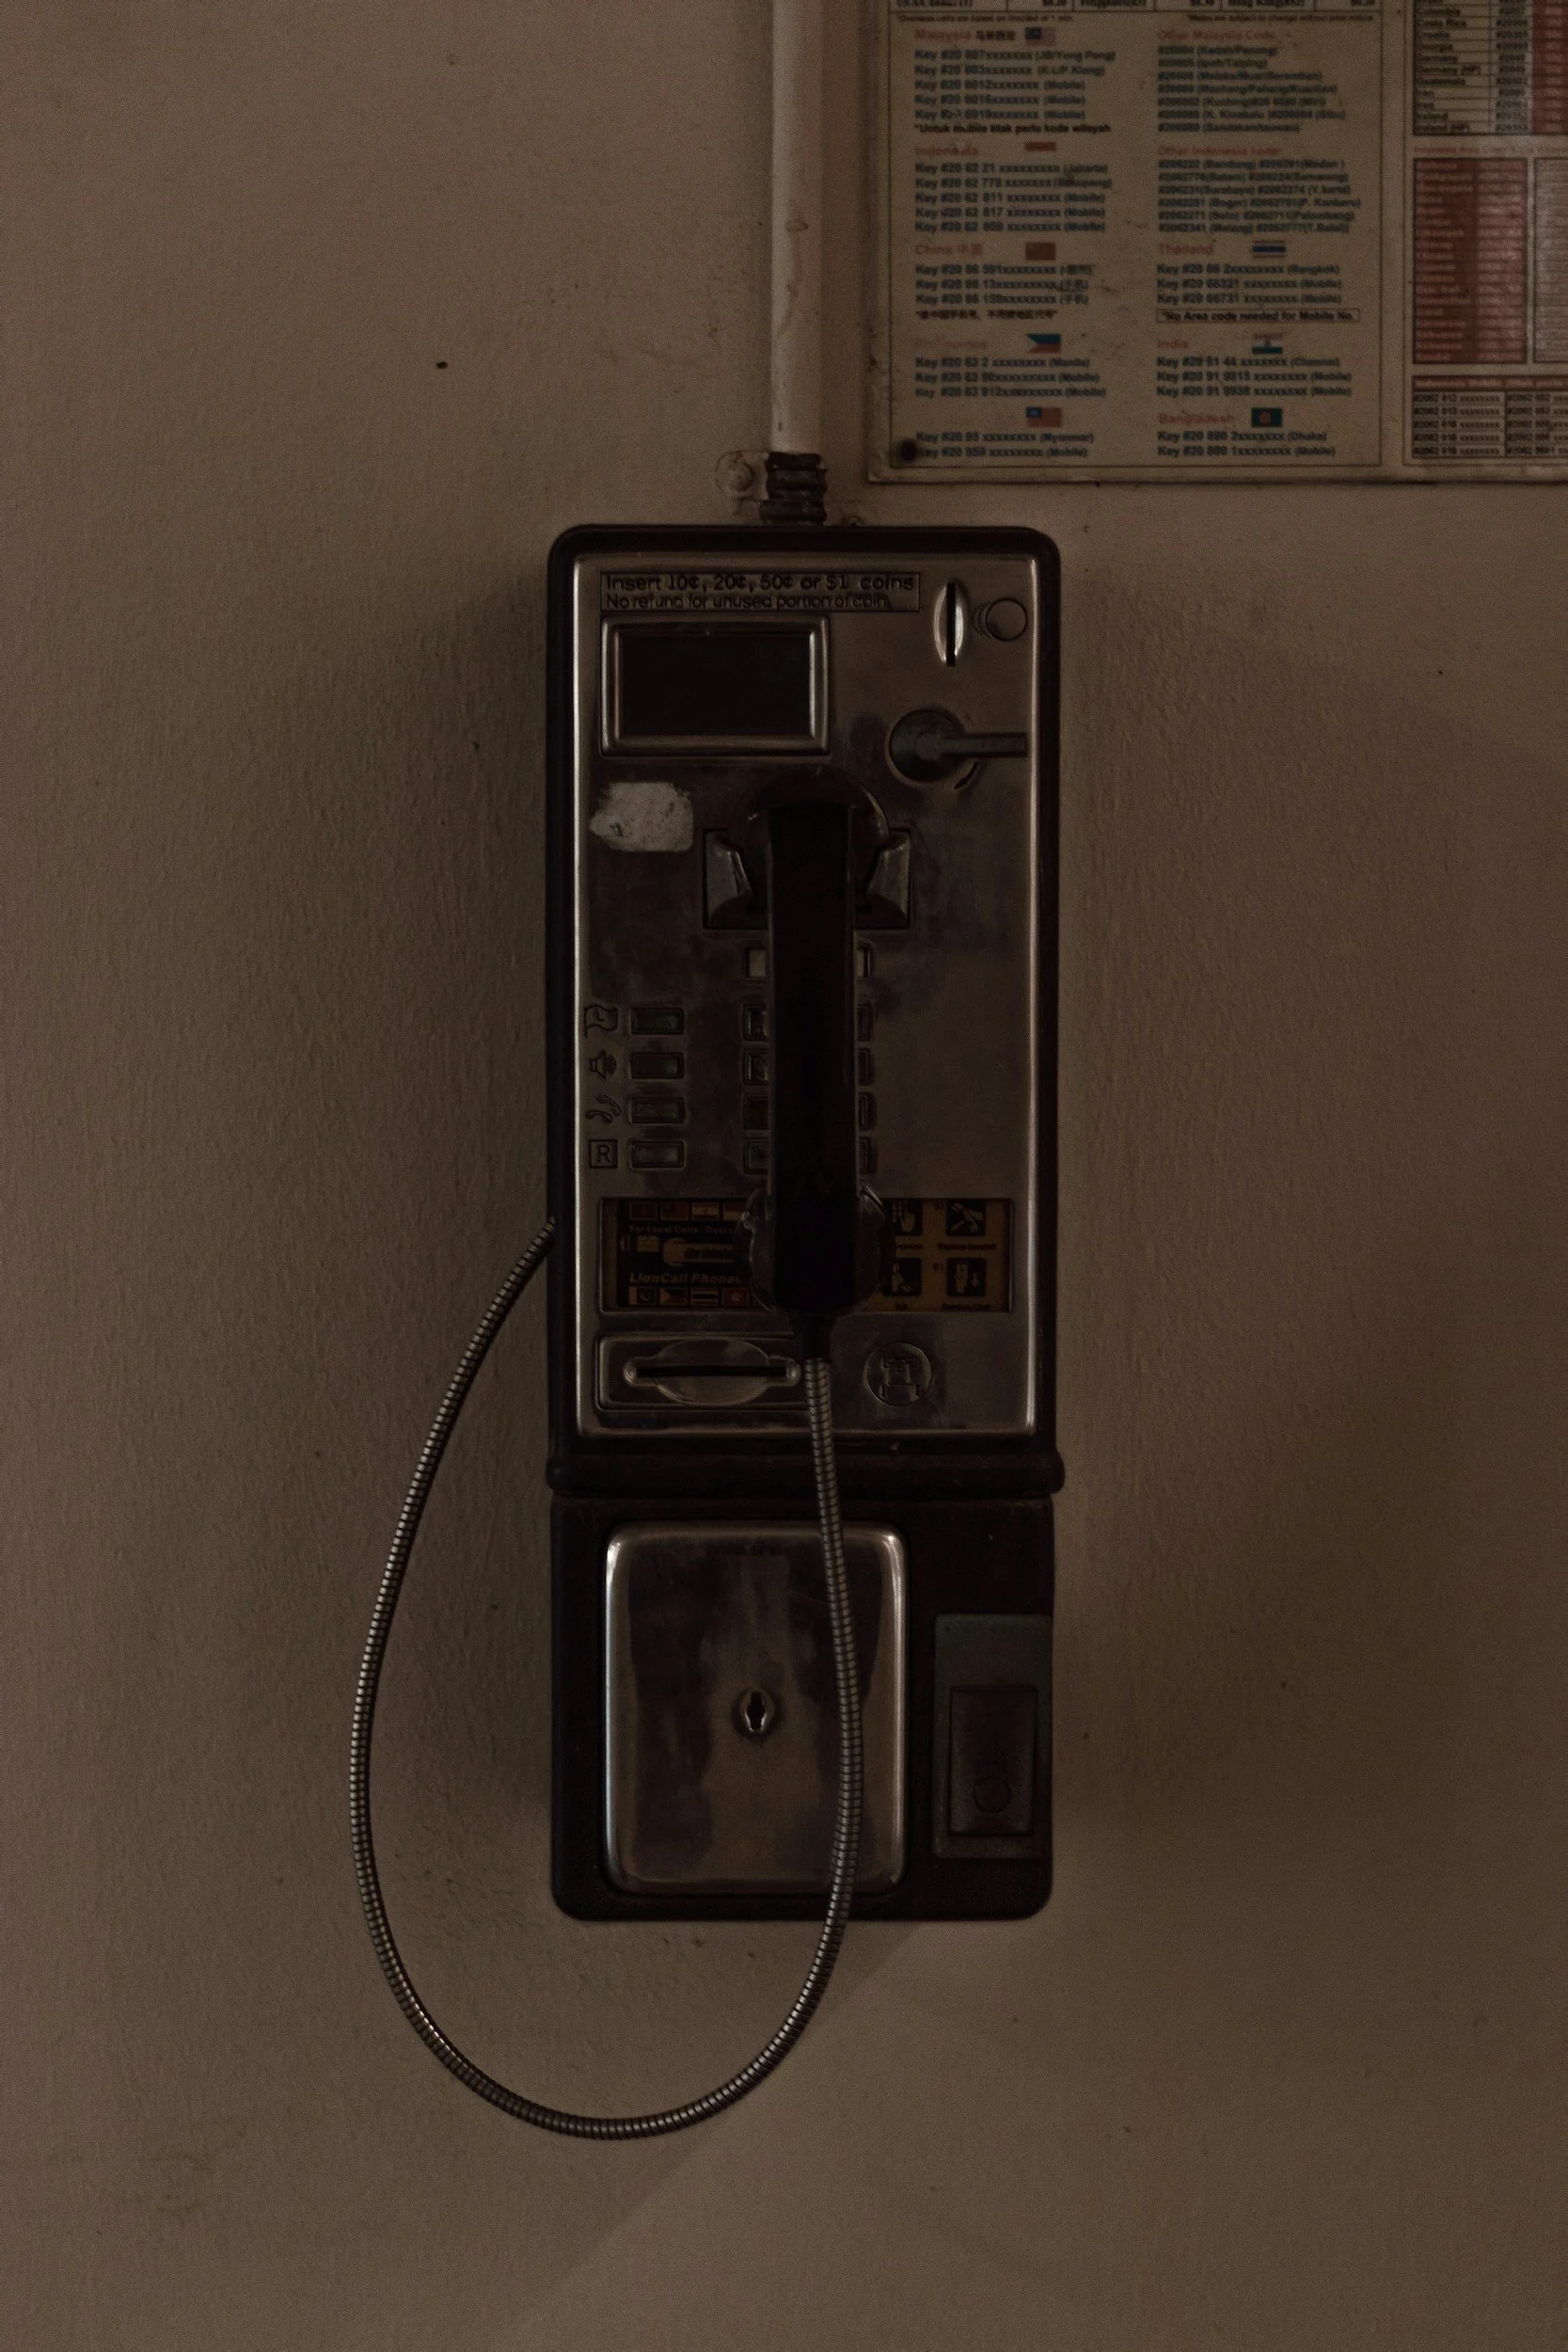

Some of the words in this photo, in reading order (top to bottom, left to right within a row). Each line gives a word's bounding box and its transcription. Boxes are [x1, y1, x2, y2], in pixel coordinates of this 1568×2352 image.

[914, 50, 937, 60] Key
[914, 66, 937, 76] Key
[914, 80, 938, 91] Key
[1044, 81, 1085, 89] (Mobile)
[914, 95, 937, 106] Key
[1044, 95, 1085, 104] (Mobile)
[915, 110, 937, 120] Key
[1044, 110, 1085, 119] (Mobile)
[1045, 124, 1069, 133] kode
[915, 163, 938, 175] Key
[915, 178, 938, 189] Key
[915, 193, 938, 204] Key
[1064, 194, 1105, 202] (Mobile)
[915, 208, 938, 219] Key
[915, 222, 937, 233] Key
[1064, 222, 1106, 231] (Mobile)
[915, 244, 953, 255] China
[1159, 244, 1214, 255] Thailand
[915, 264, 939, 276] Key
[1157, 264, 1179, 275] Key
[1287, 265, 1339, 275] (Bangkok)
[915, 279, 938, 291] Key
[1157, 278, 1179, 291] Key
[1300, 279, 1342, 289] (Mobile)
[915, 294, 938, 305] Key
[1157, 294, 1180, 305] Key
[1184, 312, 1208, 321] Area
[1211, 312, 1237, 321] code
[1240, 312, 1278, 321] needed
[1282, 312, 1295, 321] for
[1299, 312, 1334, 321] Mobile
[1158, 340, 1189, 349] India
[915, 358, 938, 368] Key
[1157, 358, 1179, 368] Key
[1224, 357, 1237, 366] 44
[915, 373, 938, 384] Key
[1058, 373, 1100, 382] (Mobile)
[1157, 372, 1180, 383] Key
[1310, 372, 1352, 381] (Mobile)
[915, 388, 938, 398] Key
[1065, 388, 1106, 396] (Mobile)
[1156, 387, 1180, 398] Key
[1310, 387, 1352, 396] (Mobile)
[914, 432, 938, 445] Key
[1157, 431, 1180, 442] Key
[1288, 432, 1327, 441] (Dhaka)
[917, 445, 938, 460] Key
[1158, 446, 1180, 457] Key
[1294, 447, 1336, 456] (Mobile)
[607, 575, 661, 590] Insert
[669, 575, 708, 596] 10¢,
[715, 575, 755, 596] 20¢,
[761, 575, 793, 590] 50¢
[800, 579, 822, 590] or
[827, 575, 847, 592] $1
[861, 575, 915, 590] coins
[607, 594, 632, 609] No
[634, 594, 684, 609] refund
[687, 594, 708, 609] for
[714, 594, 771, 609] unused
[778, 594, 833, 612] portion
[836, 594, 850, 609] of
[852, 594, 890, 609] coin
[597, 1145, 611, 1163] R
[629, 1272, 689, 1284] LionCall
